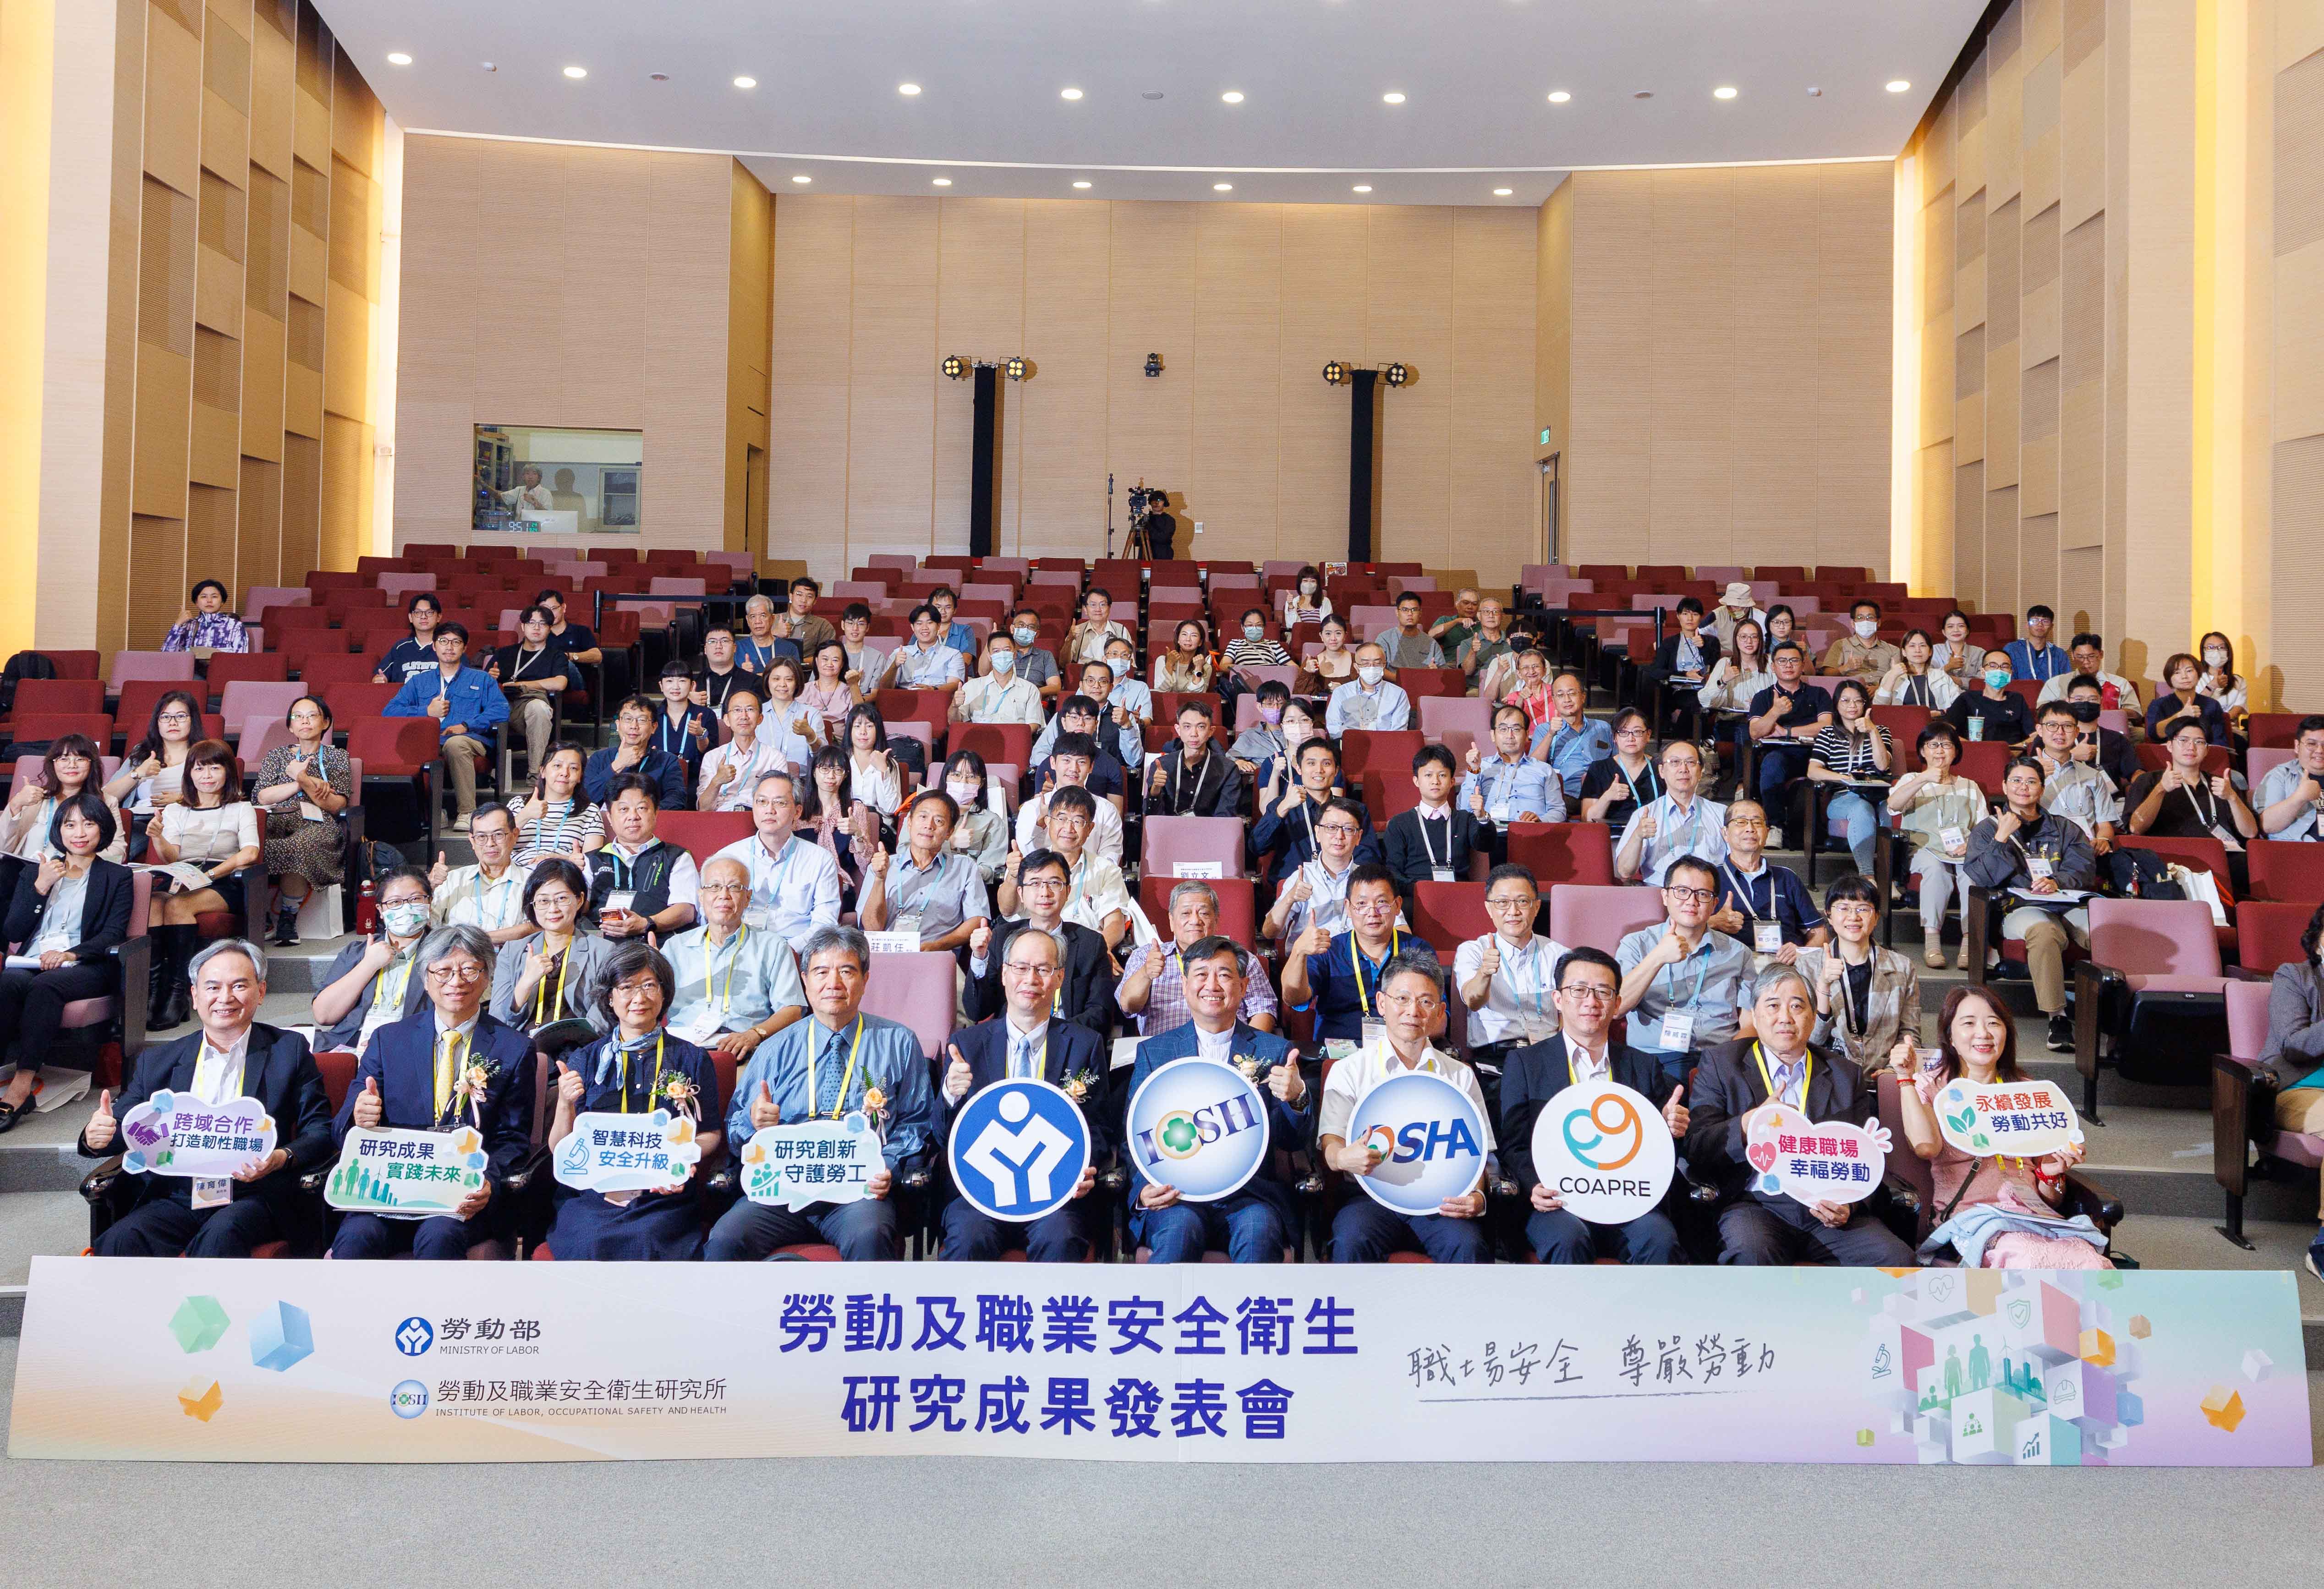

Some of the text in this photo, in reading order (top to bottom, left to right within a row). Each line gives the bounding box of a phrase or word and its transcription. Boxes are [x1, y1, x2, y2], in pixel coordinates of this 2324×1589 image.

[871, 943, 904, 952] 莊凱任
[1975, 1091, 2054, 1112] 永續發展
[172, 1112, 254, 1135] 跨域合作
[1990, 1112, 2068, 1133] 勞動共好
[170, 1133, 264, 1152] 打造韌性職場
[359, 1139, 434, 1160] 研究成果
[592, 1129, 662, 1149] 智慧科技
[774, 1140, 856, 1159] 研究創新
[1778, 1134, 1859, 1158] 健康職場
[598, 1150, 669, 1170] 安全升級
[386, 1162, 461, 1183] 實踐未來
[785, 1164, 866, 1183] 守護勞工
[1790, 1159, 1870, 1183] 幸福勞動
[1559, 1177, 1650, 1197] COAPRE
[440, 1318, 541, 1341] 勞動部
[779, 1293, 1359, 1355] 勞動及職業安全衛生
[440, 1346, 539, 1354] MINISTRY OF LABOR
[1408, 1333, 1774, 1388] 職場安全 尊嚴勞動
[437, 1379, 727, 1402] 勞動及職業安全衛生研究所
[509, 1408, 543, 1417] LABOR,
[548, 1408, 624, 1416] OCCUPATIONAL
[841, 1374, 1294, 1440] 研究成果發表會
